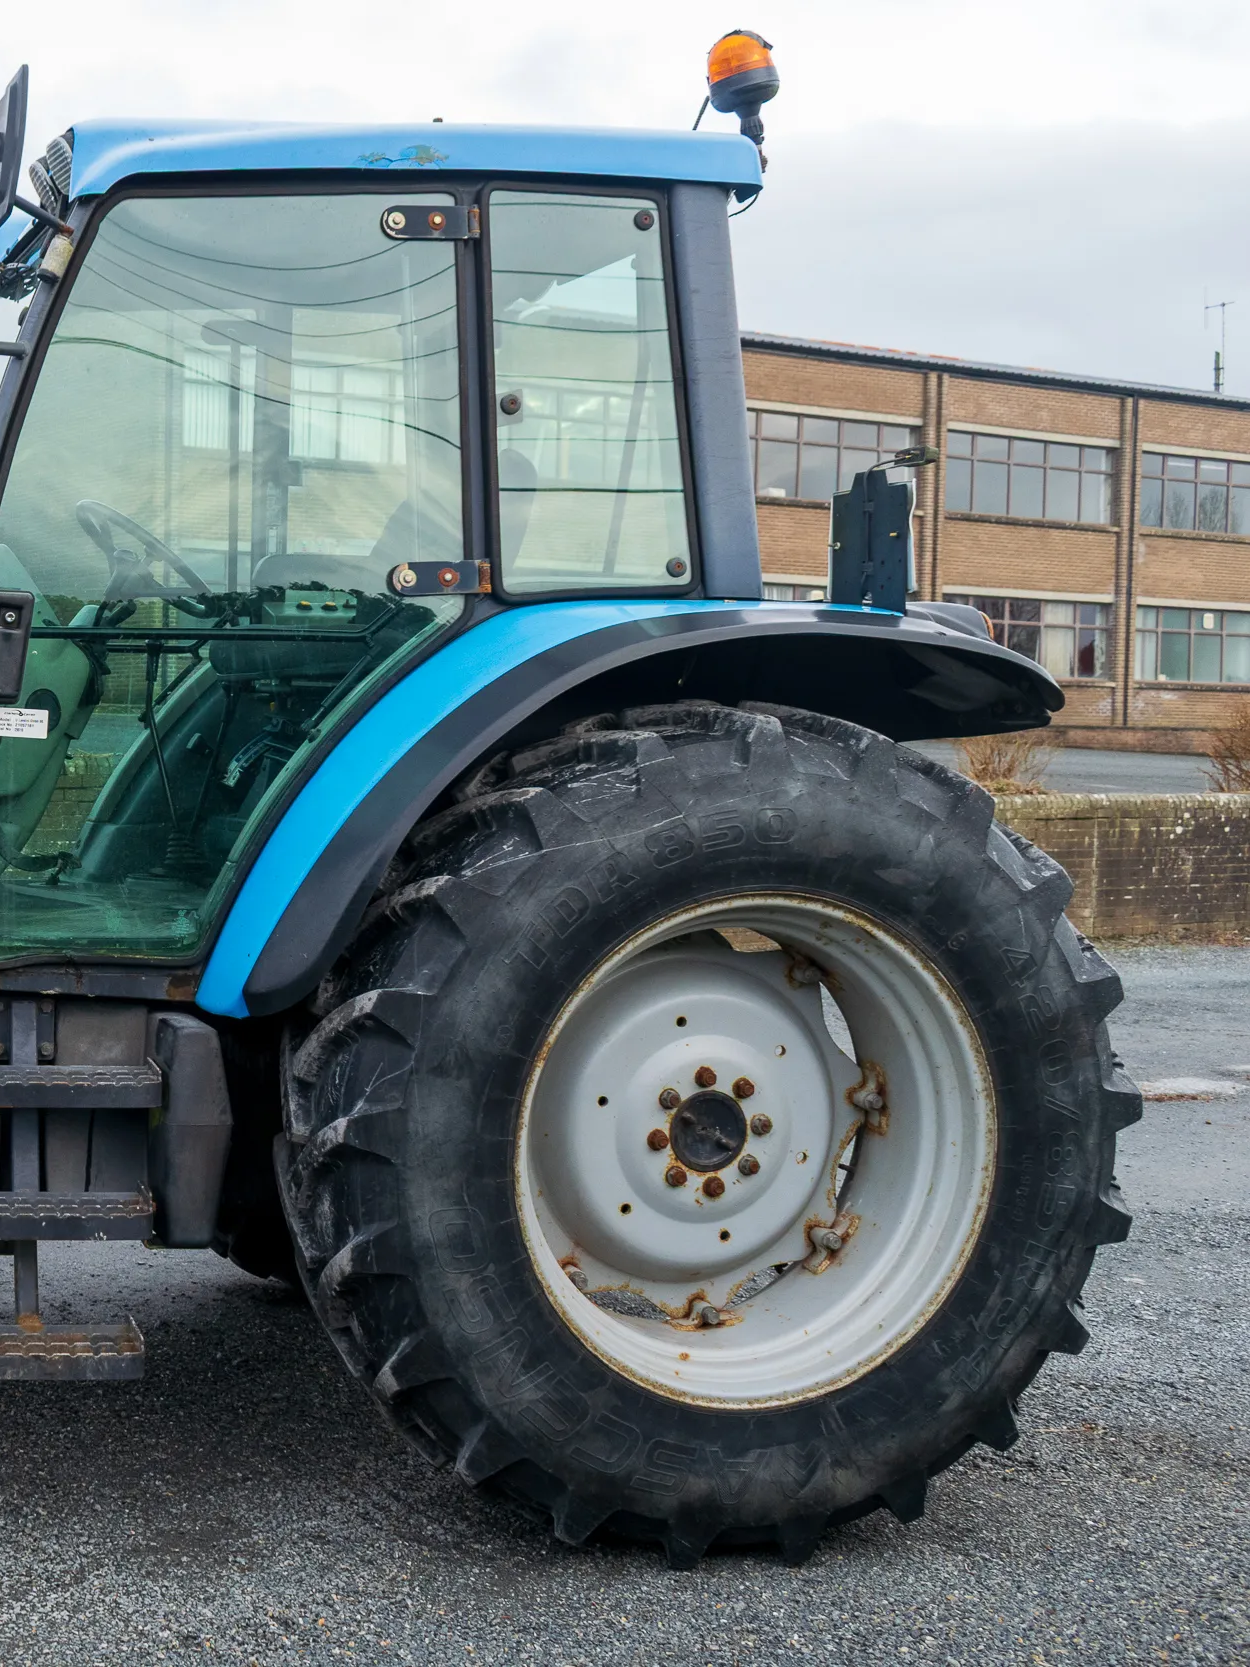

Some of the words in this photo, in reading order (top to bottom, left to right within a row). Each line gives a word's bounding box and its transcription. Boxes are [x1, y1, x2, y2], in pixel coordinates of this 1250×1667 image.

[503, 851, 640, 970] TDR
[644, 807, 798, 869] 850
[428, 1205, 765, 1507] ASCENSO
